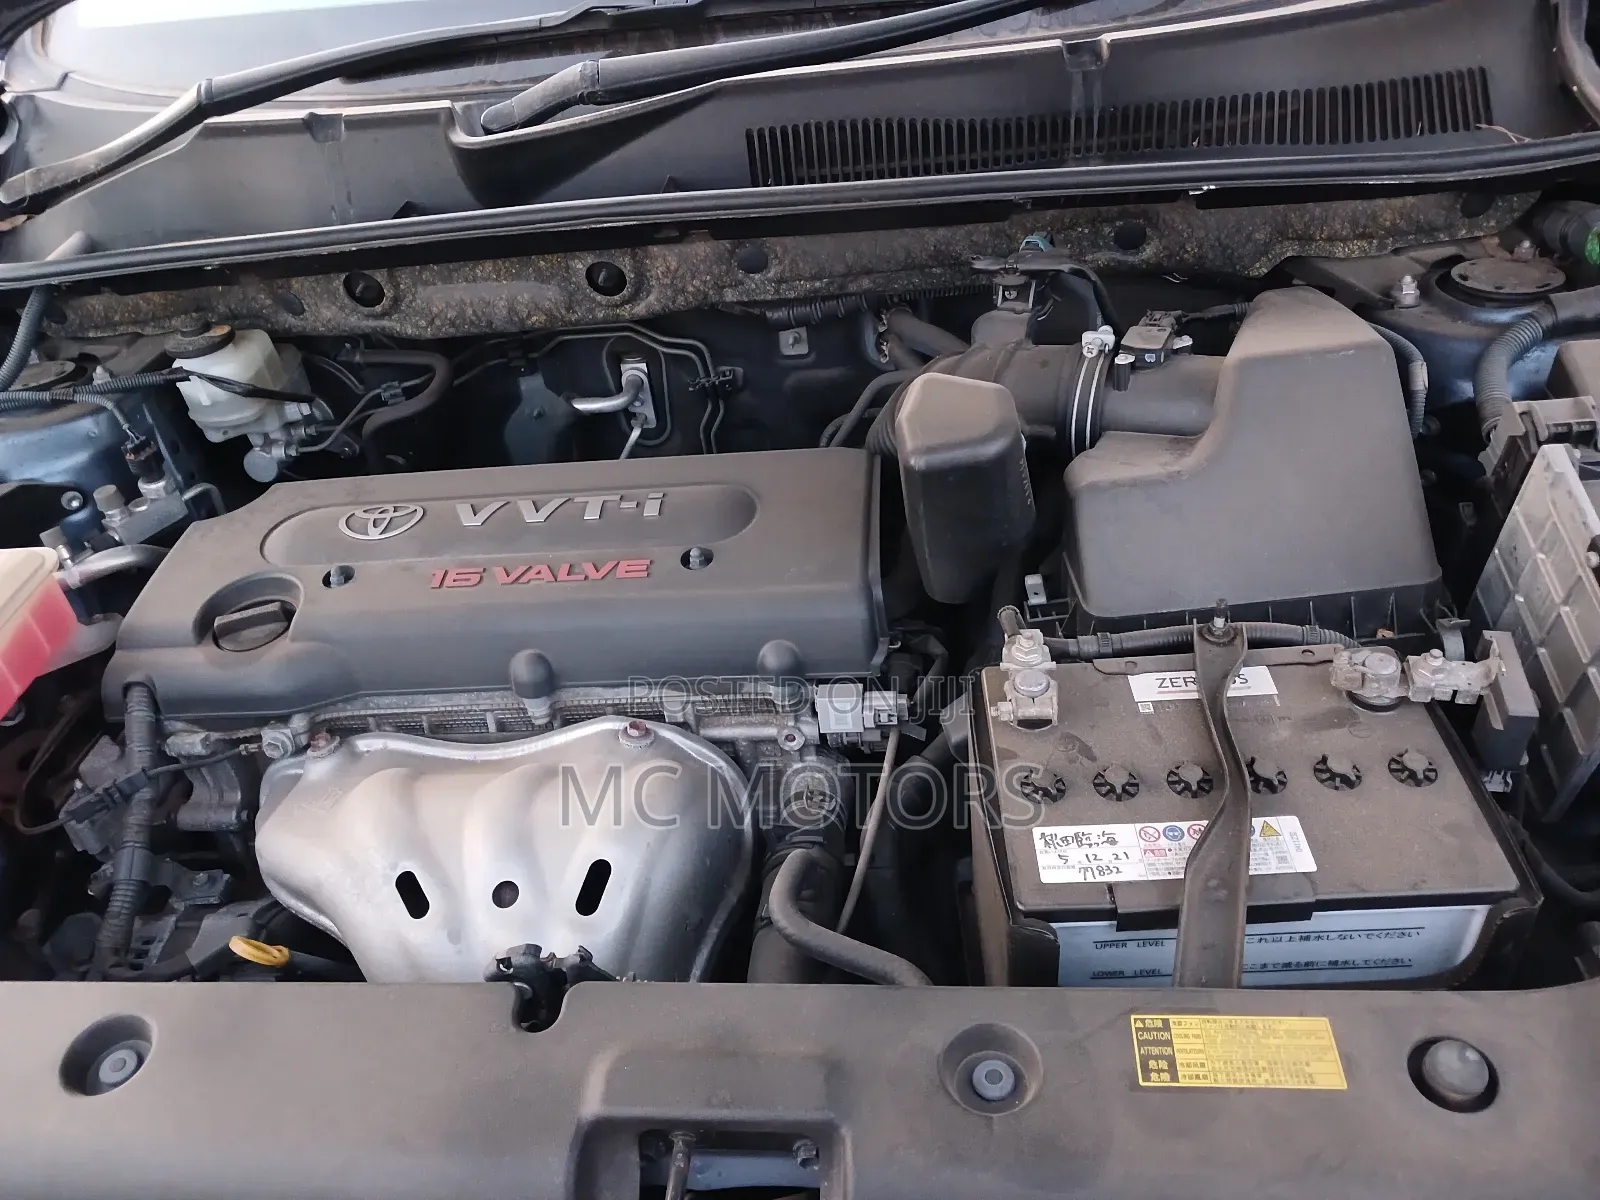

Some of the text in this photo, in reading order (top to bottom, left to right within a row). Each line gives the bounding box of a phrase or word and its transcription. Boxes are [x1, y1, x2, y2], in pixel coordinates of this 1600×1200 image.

[455, 491, 665, 527] VVT-i
[430, 558, 653, 589] 16 VALVE
[1095, 940, 1166, 950] UPPER LEVEL
[1132, 968, 1163, 976] LEVEL
[1137, 1031, 1171, 1041] CAUTION
[1140, 1046, 1173, 1056] ATTENTION
